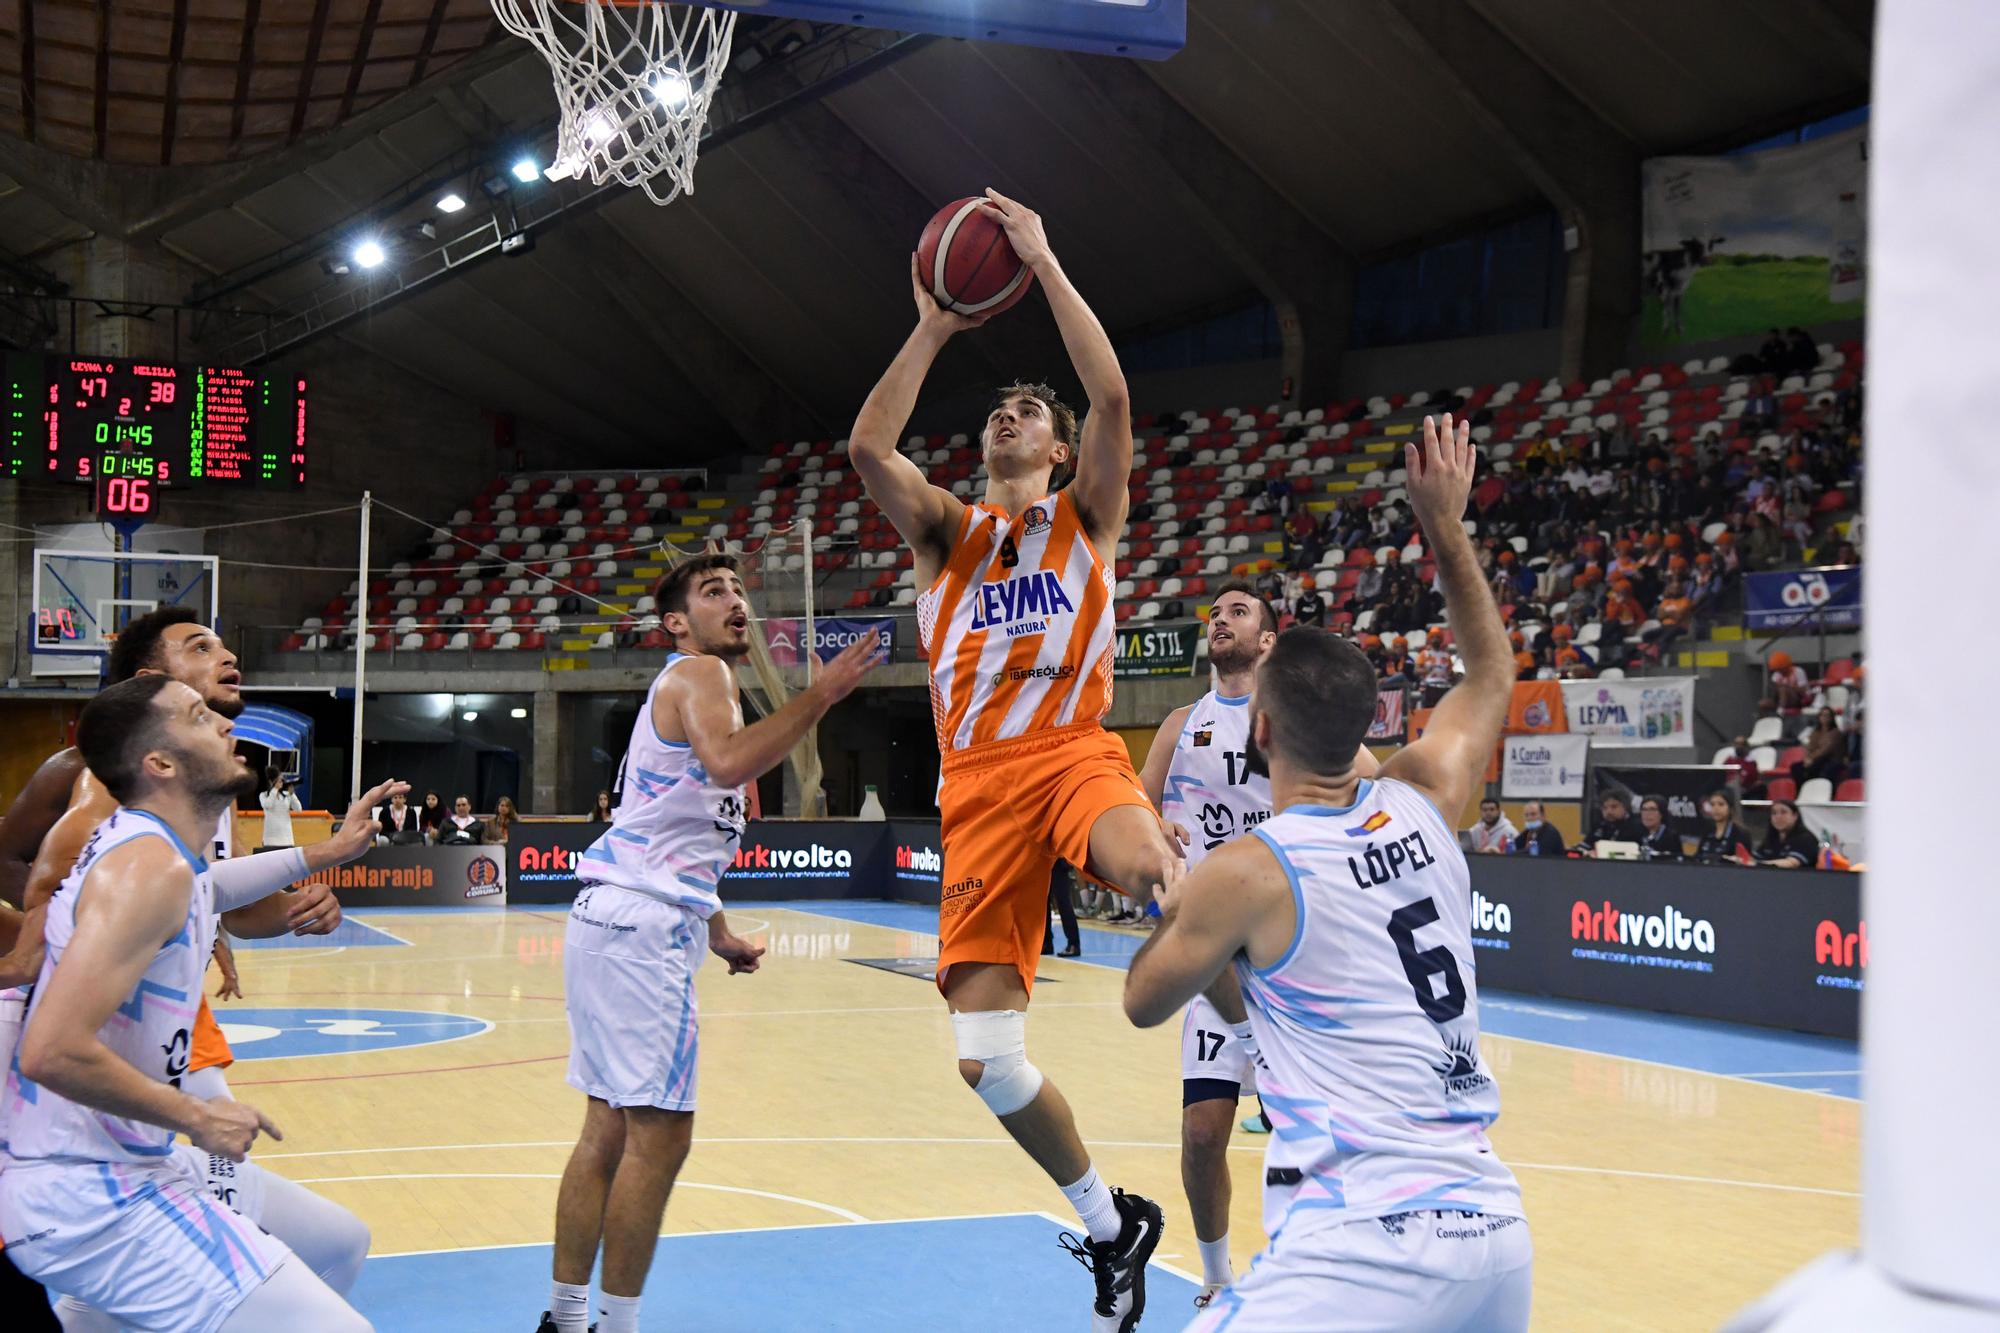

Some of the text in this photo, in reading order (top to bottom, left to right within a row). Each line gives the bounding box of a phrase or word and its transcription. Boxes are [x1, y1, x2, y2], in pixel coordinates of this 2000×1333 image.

[133, 365, 177, 378] MELILLA
[81, 378, 107, 398] 47
[150, 381, 175, 403] 38
[119, 397, 132, 416] 2
[95, 422, 152, 446] 01:45
[103, 455, 154, 476] 01:45
[106, 478, 150, 512] 06
[1000, 536, 1020, 568] 9
[971, 571, 1074, 630] LEYMA
[801, 630, 891, 649] abecona
[1006, 620, 1047, 637] NATURA
[1113, 632, 1185, 658] MASTIL
[1009, 664, 1075, 681] IBEREÓLICA
[1580, 705, 1629, 725] LEYMA
[1222, 751, 1251, 786] 17
[896, 845, 941, 872] Arkivolta
[1347, 830, 1436, 890] LÓPEZ
[1571, 900, 1716, 954] Arkivolta
[1386, 896, 1468, 1025] 6
[1196, 1029, 1226, 1061] 17
